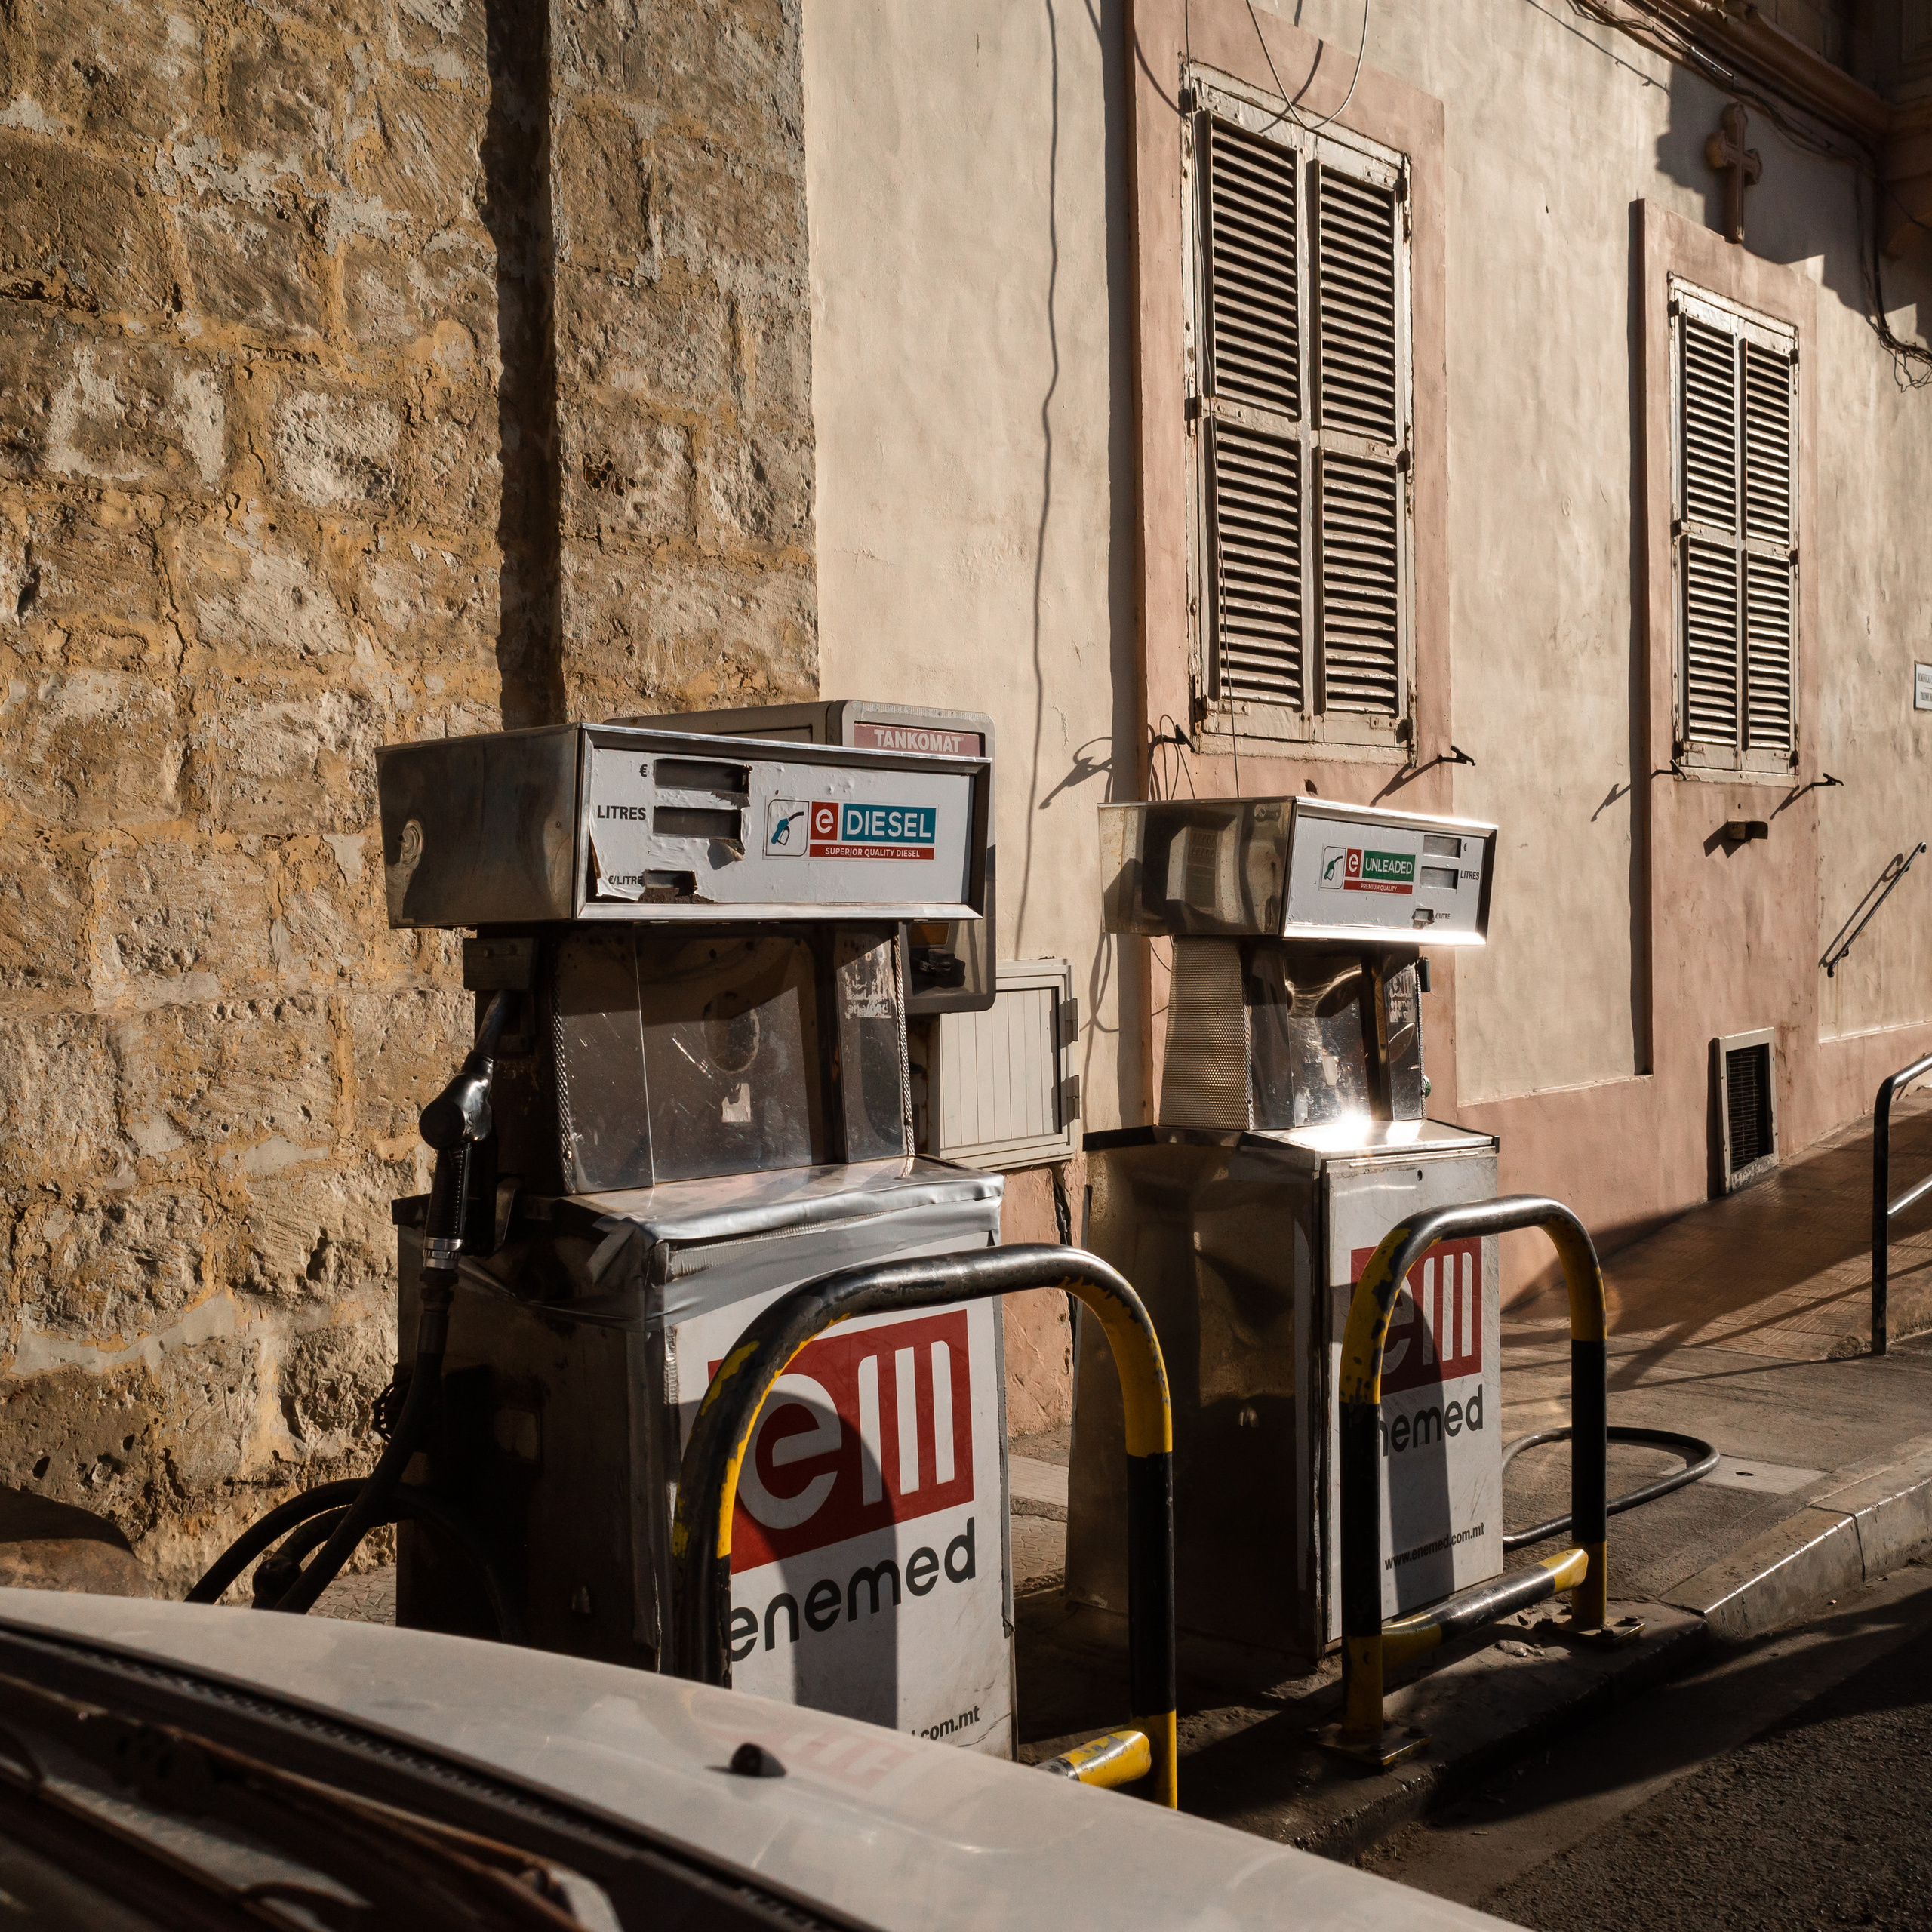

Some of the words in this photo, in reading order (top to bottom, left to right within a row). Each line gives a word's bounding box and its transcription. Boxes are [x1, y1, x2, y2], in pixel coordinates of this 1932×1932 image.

[874, 729, 961, 753] TANKOMAT
[639, 764, 648, 777] €
[597, 804, 647, 821] LITRES
[815, 808, 835, 834] e
[846, 809, 932, 838] DIESEL
[825, 847, 863, 857] SUPERIOR
[864, 848, 895, 858] QUALITY
[896, 849, 920, 858] DIESEL
[1348, 853, 1359, 873] e
[1365, 857, 1414, 875] UNLEADED
[1460, 870, 1480, 881] LITRES
[1360, 882, 1380, 891] PREMIUM
[1380, 884, 1398, 892] QUALITY
[1380, 1383, 1484, 1457] nemed
[1384, 1521, 1485, 1571] www.enemed.com.mt
[731, 1516, 976, 1663] enemed
